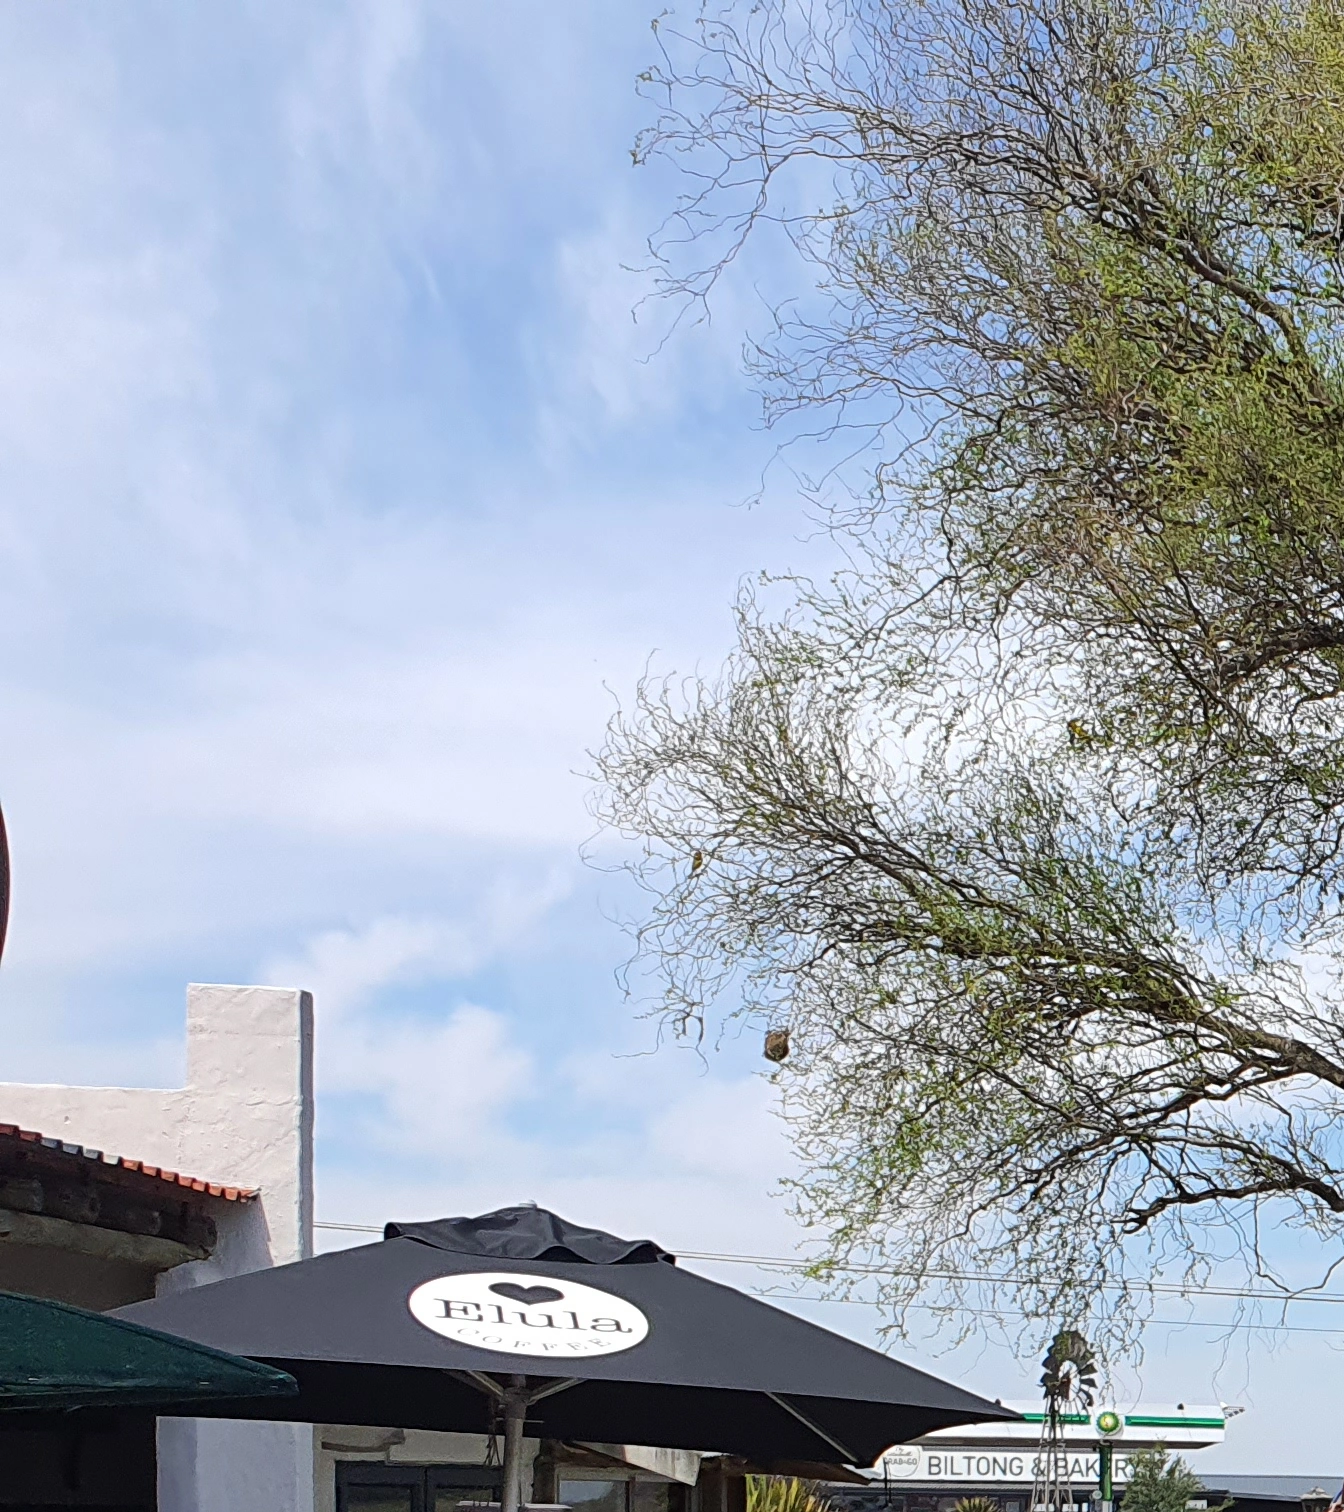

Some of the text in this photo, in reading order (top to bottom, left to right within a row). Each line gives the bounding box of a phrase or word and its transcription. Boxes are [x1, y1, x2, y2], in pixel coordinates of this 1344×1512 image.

[433, 1297, 634, 1334] Elula
[457, 1327, 612, 1351] COFFEE
[928, 1455, 1024, 1477] BILTONG
[1055, 1457, 1138, 1478] BAKR
